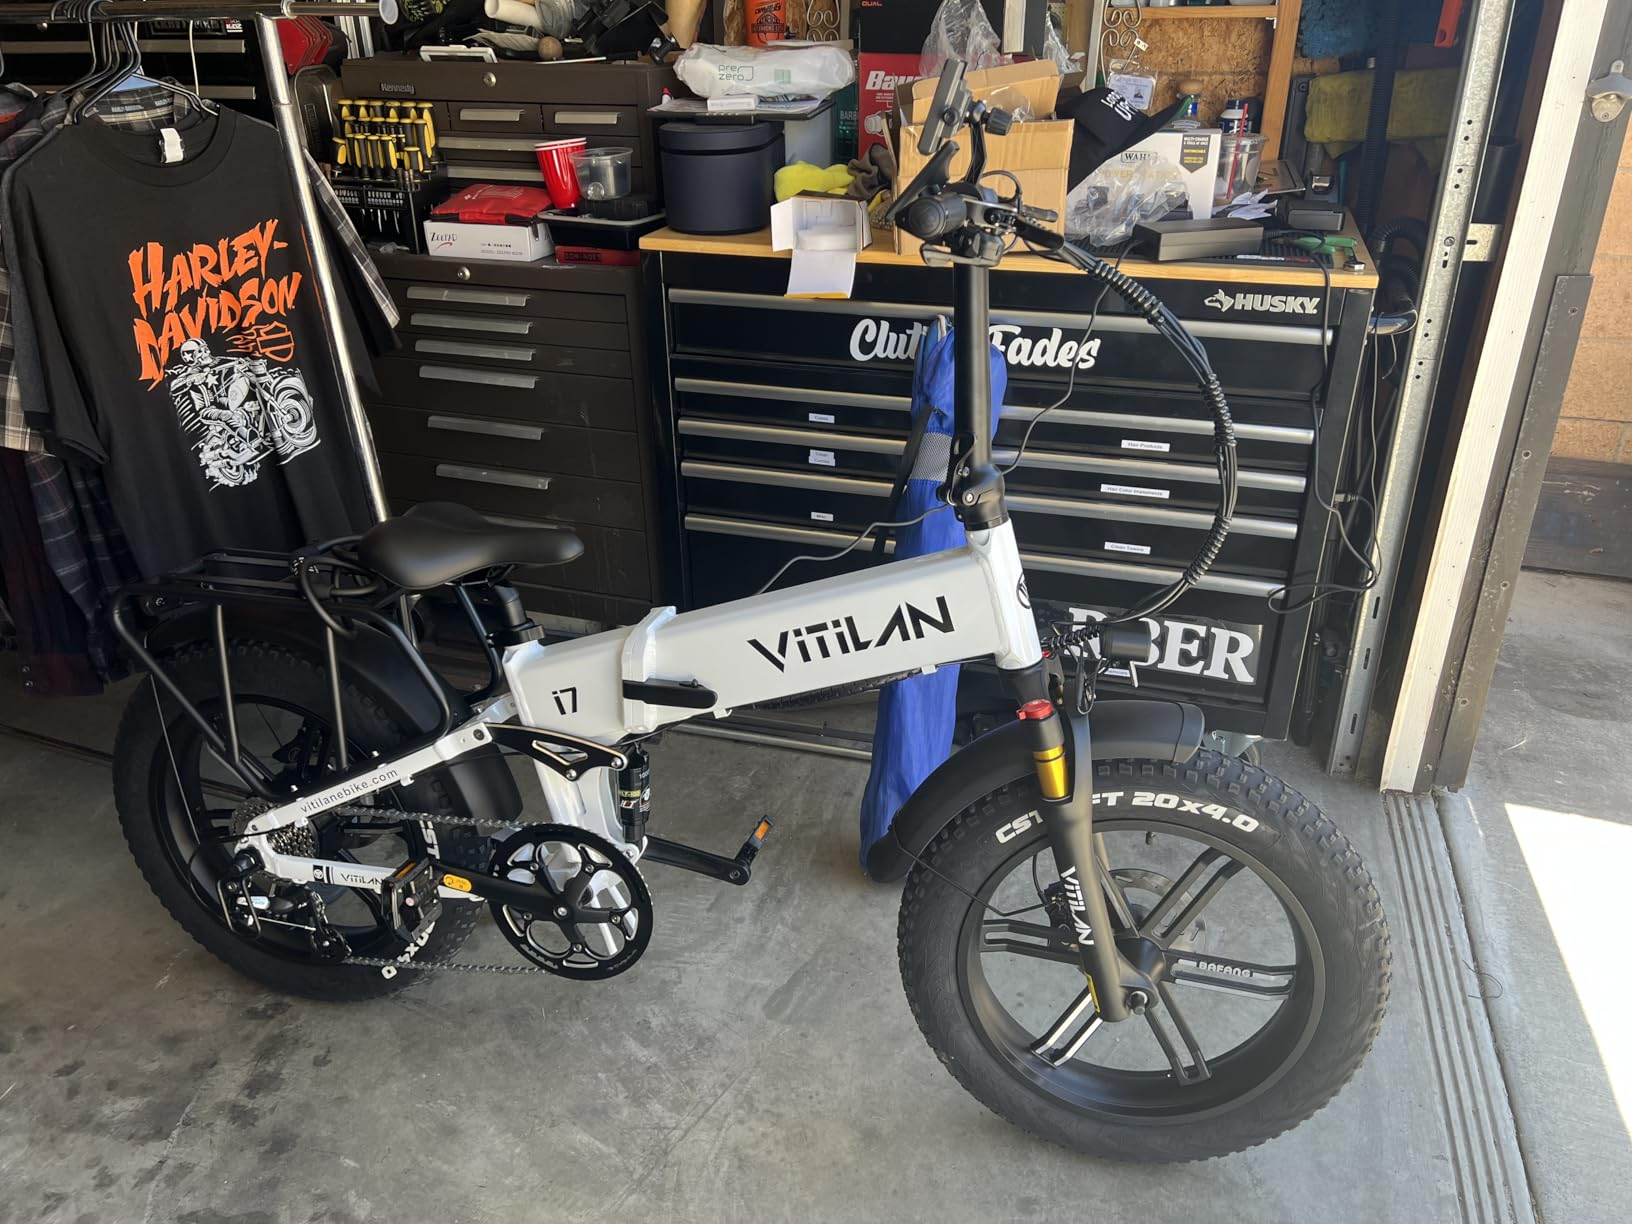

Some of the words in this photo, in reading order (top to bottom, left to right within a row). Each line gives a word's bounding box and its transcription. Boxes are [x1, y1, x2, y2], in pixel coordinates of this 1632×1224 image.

[719, 65, 738, 73] pre
[720, 73, 745, 81] zero
[380, 82, 415, 95] Kennedy
[128, 219, 288, 320] HARLEY-
[1234, 293, 1320, 314] HUSKY
[133, 271, 302, 392] DAVIDSON
[988, 324, 1101, 370] Fades
[552, 687, 577, 715] i7
[300, 769, 399, 813] vitilanebike.com
[1131, 791, 1260, 833] 20x4.0
[1199, 961, 1251, 978] BAFANG
